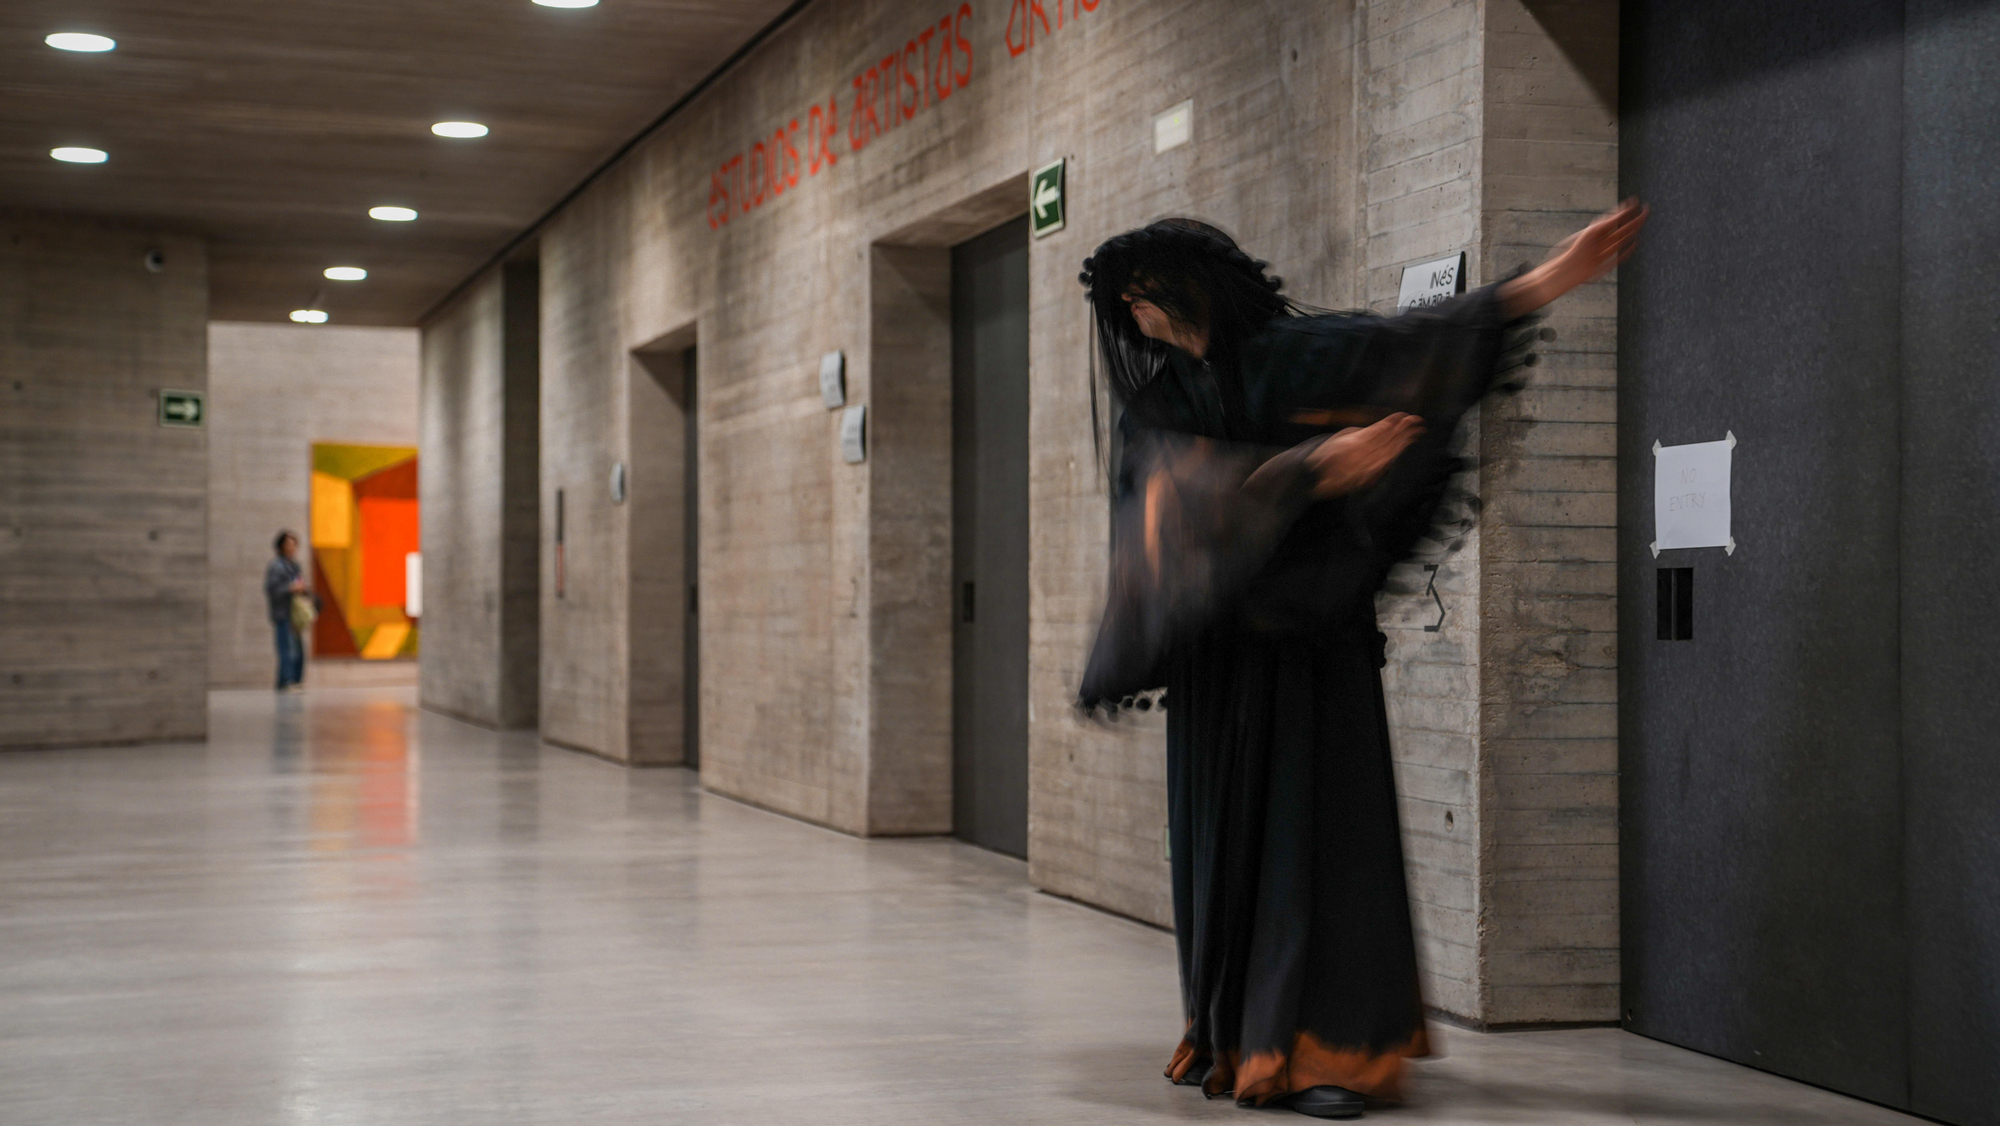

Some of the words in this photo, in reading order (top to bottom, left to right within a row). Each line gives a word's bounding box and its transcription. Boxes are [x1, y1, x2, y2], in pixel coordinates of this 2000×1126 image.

[1680, 467, 1697, 485] NO
[1669, 491, 1706, 512] ENTRY
[1423, 564, 1445, 632] 3
